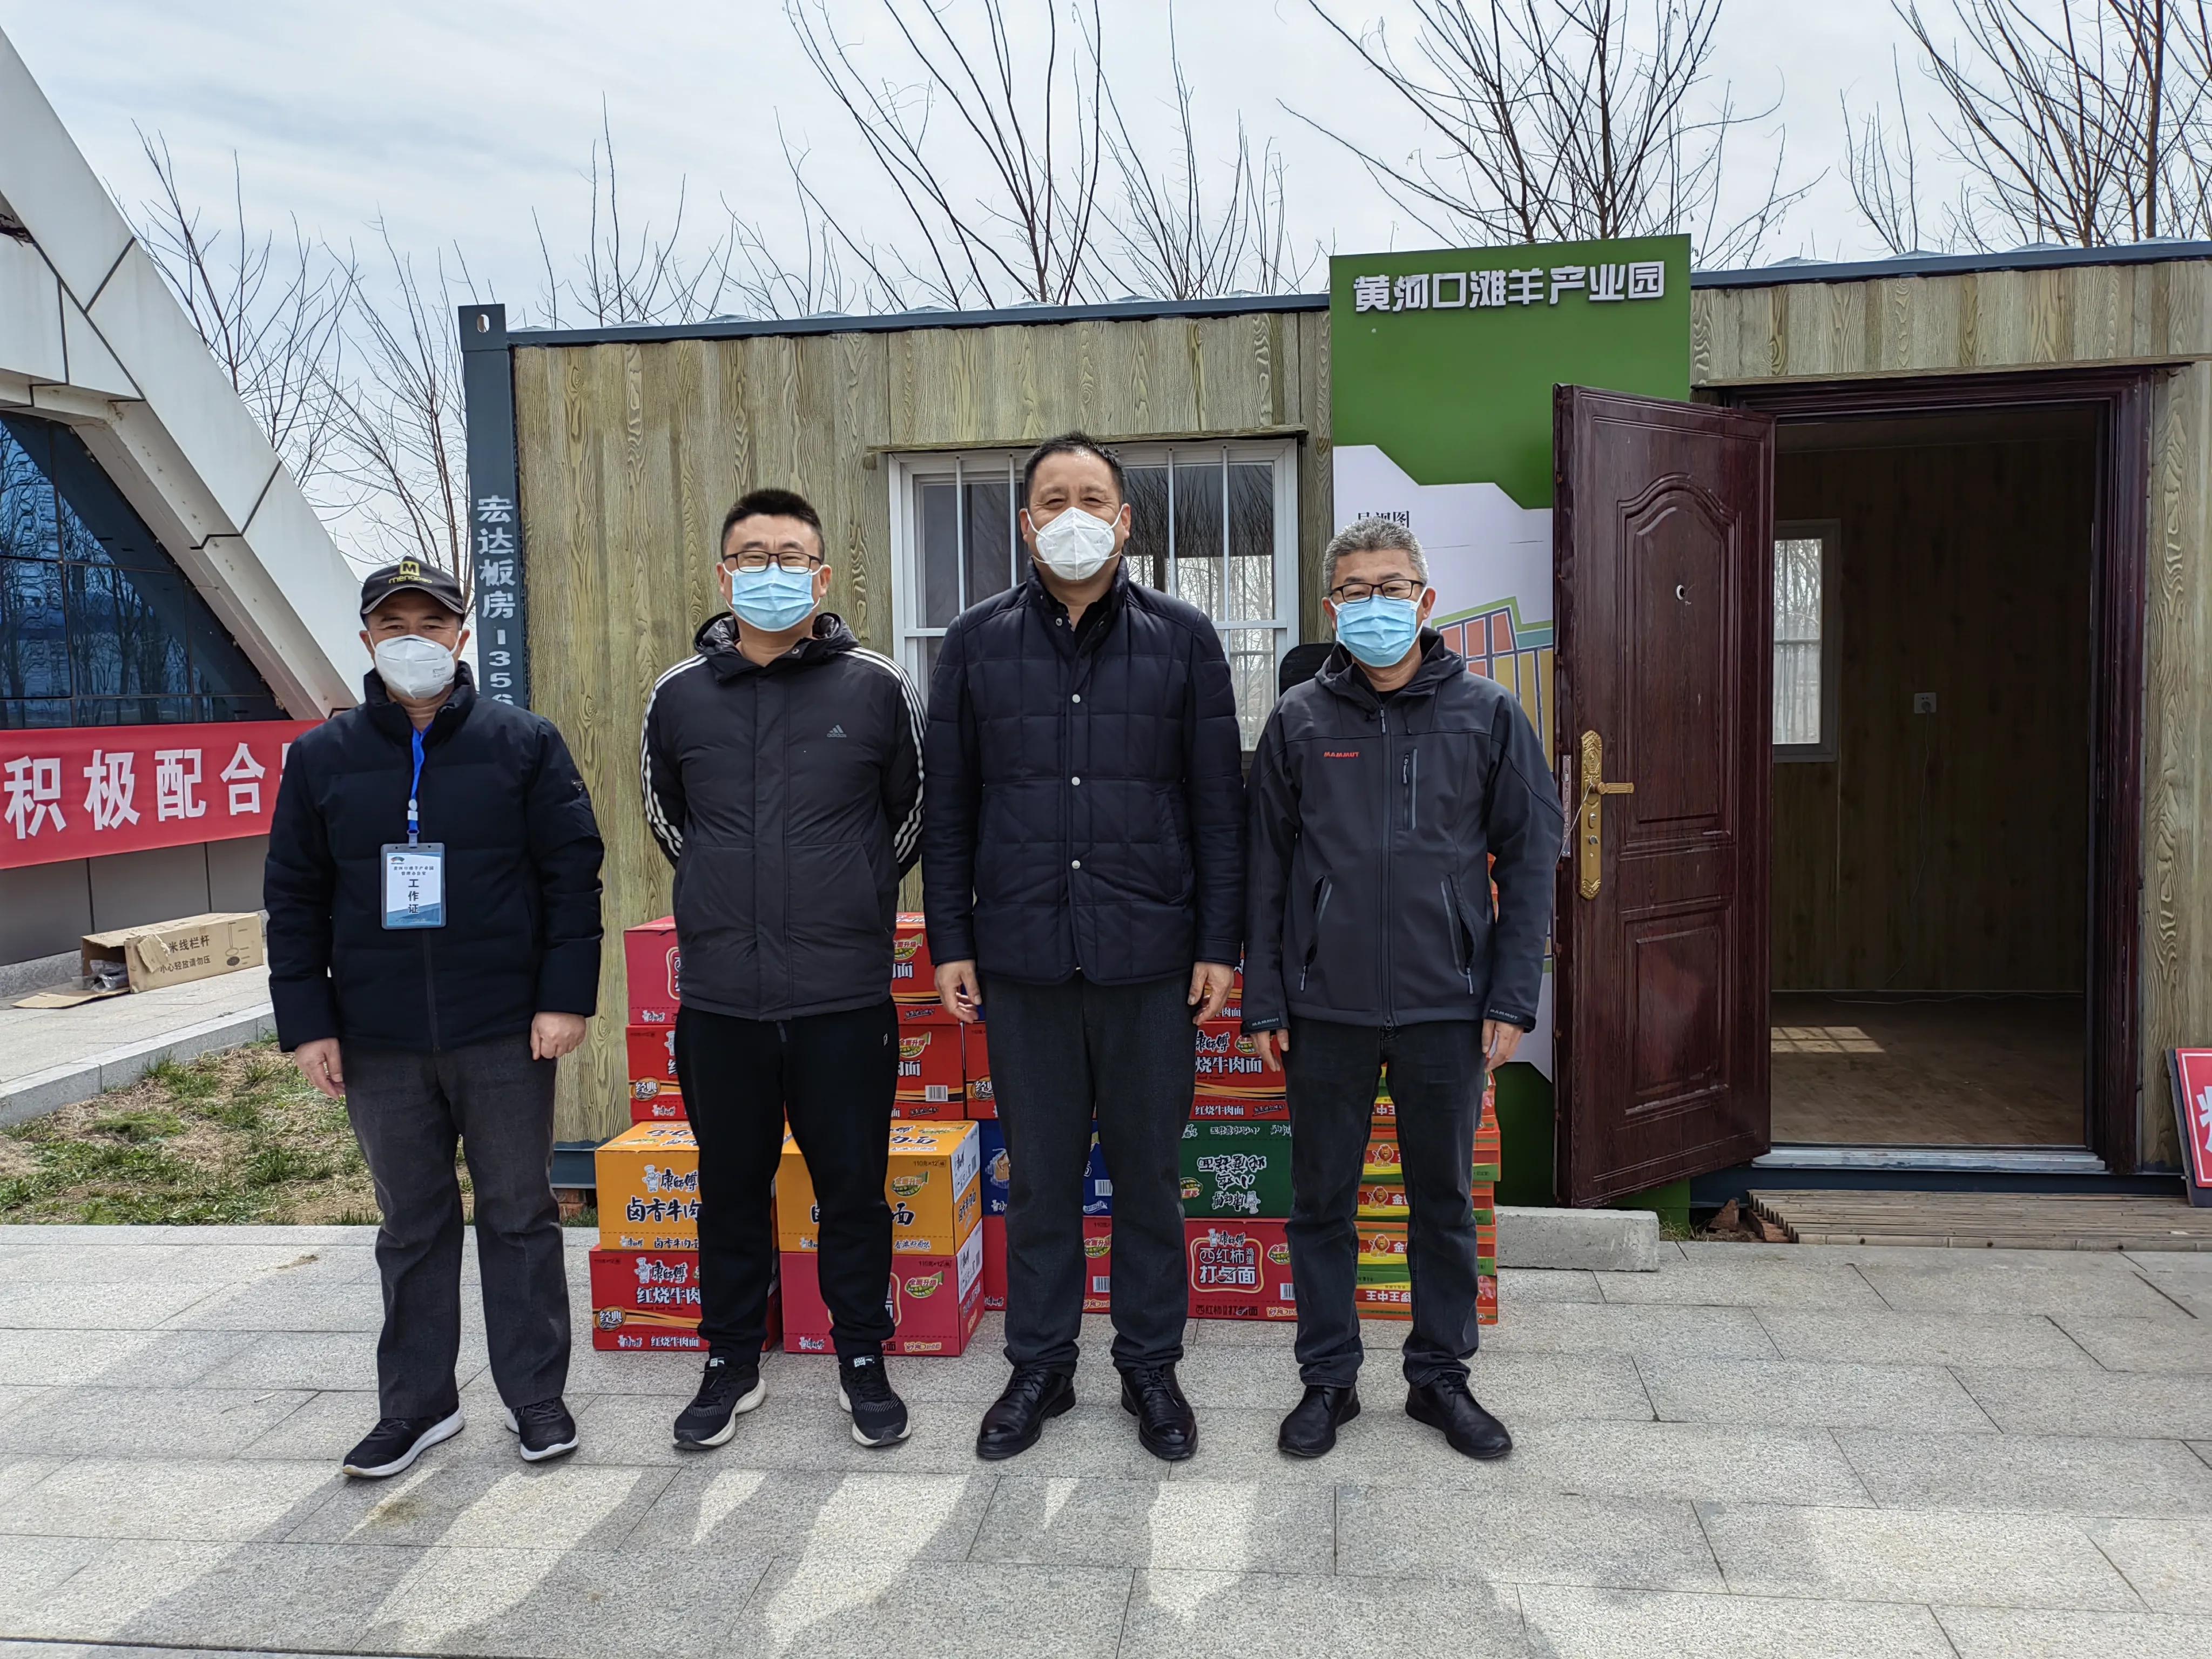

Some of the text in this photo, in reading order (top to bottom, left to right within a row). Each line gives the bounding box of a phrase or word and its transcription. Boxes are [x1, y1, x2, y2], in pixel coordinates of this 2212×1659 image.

[1353, 261, 1665, 313] 黄河口滩羊产业园
[4, 742, 291, 840] 积极配合
[408, 879, 420, 914] 工作证
[1217, 1006, 1242, 1018] 肉面
[1251, 1017, 1279, 1027] MAMMUT
[1195, 1105, 1244, 1116] 红烧牛肉面
[1197, 1154, 1267, 1174] 炖蘑菇面
[1216, 1172, 1255, 1190] 小鸡
[1199, 1247, 1245, 1264] 西红柿
[1199, 1265, 1256, 1285] 打卤面
[636, 1286, 701, 1305] 红烧牛肉
[651, 1336, 700, 1347] 红烧牛肉面
